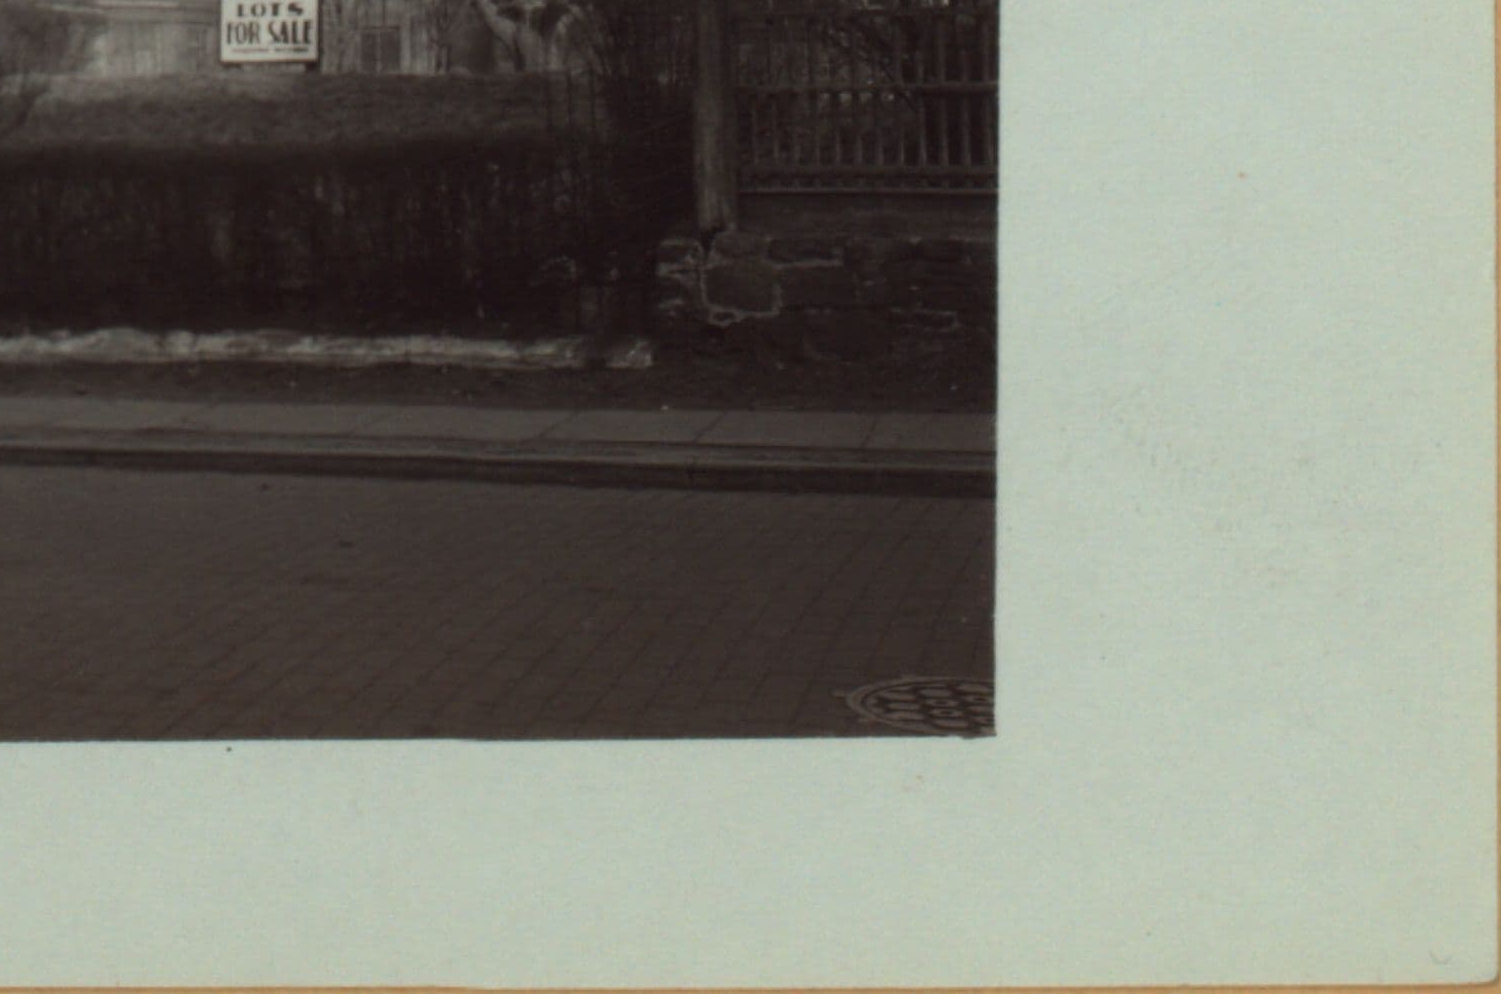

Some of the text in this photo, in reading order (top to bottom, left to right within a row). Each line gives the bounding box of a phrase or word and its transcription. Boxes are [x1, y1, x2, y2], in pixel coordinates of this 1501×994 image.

[236, 2, 304, 18] LOTS
[226, 20, 311, 45] FOR SALE
